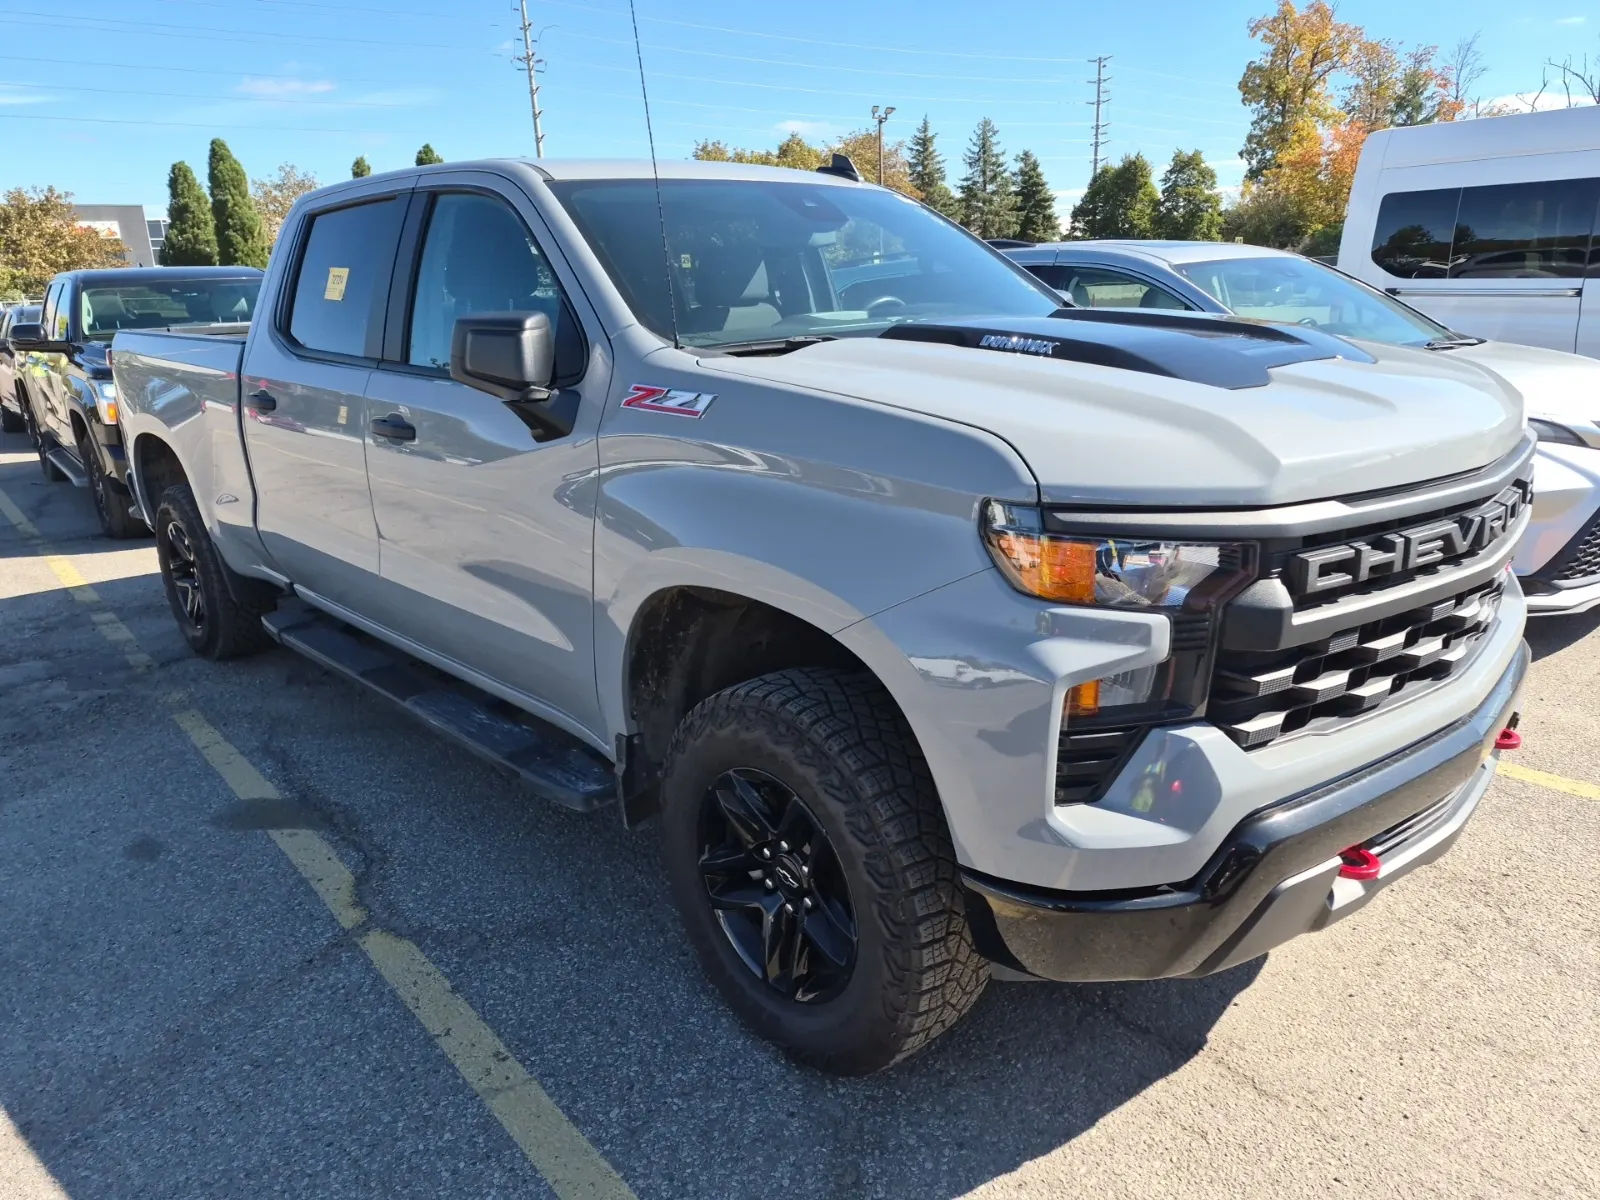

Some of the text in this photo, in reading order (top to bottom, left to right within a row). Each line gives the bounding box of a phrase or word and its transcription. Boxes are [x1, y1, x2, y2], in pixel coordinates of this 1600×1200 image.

[979, 334, 1061, 355] DURAMAX
[620, 383, 719, 419] Z71
[1296, 464, 1534, 593] CHEVROLE
